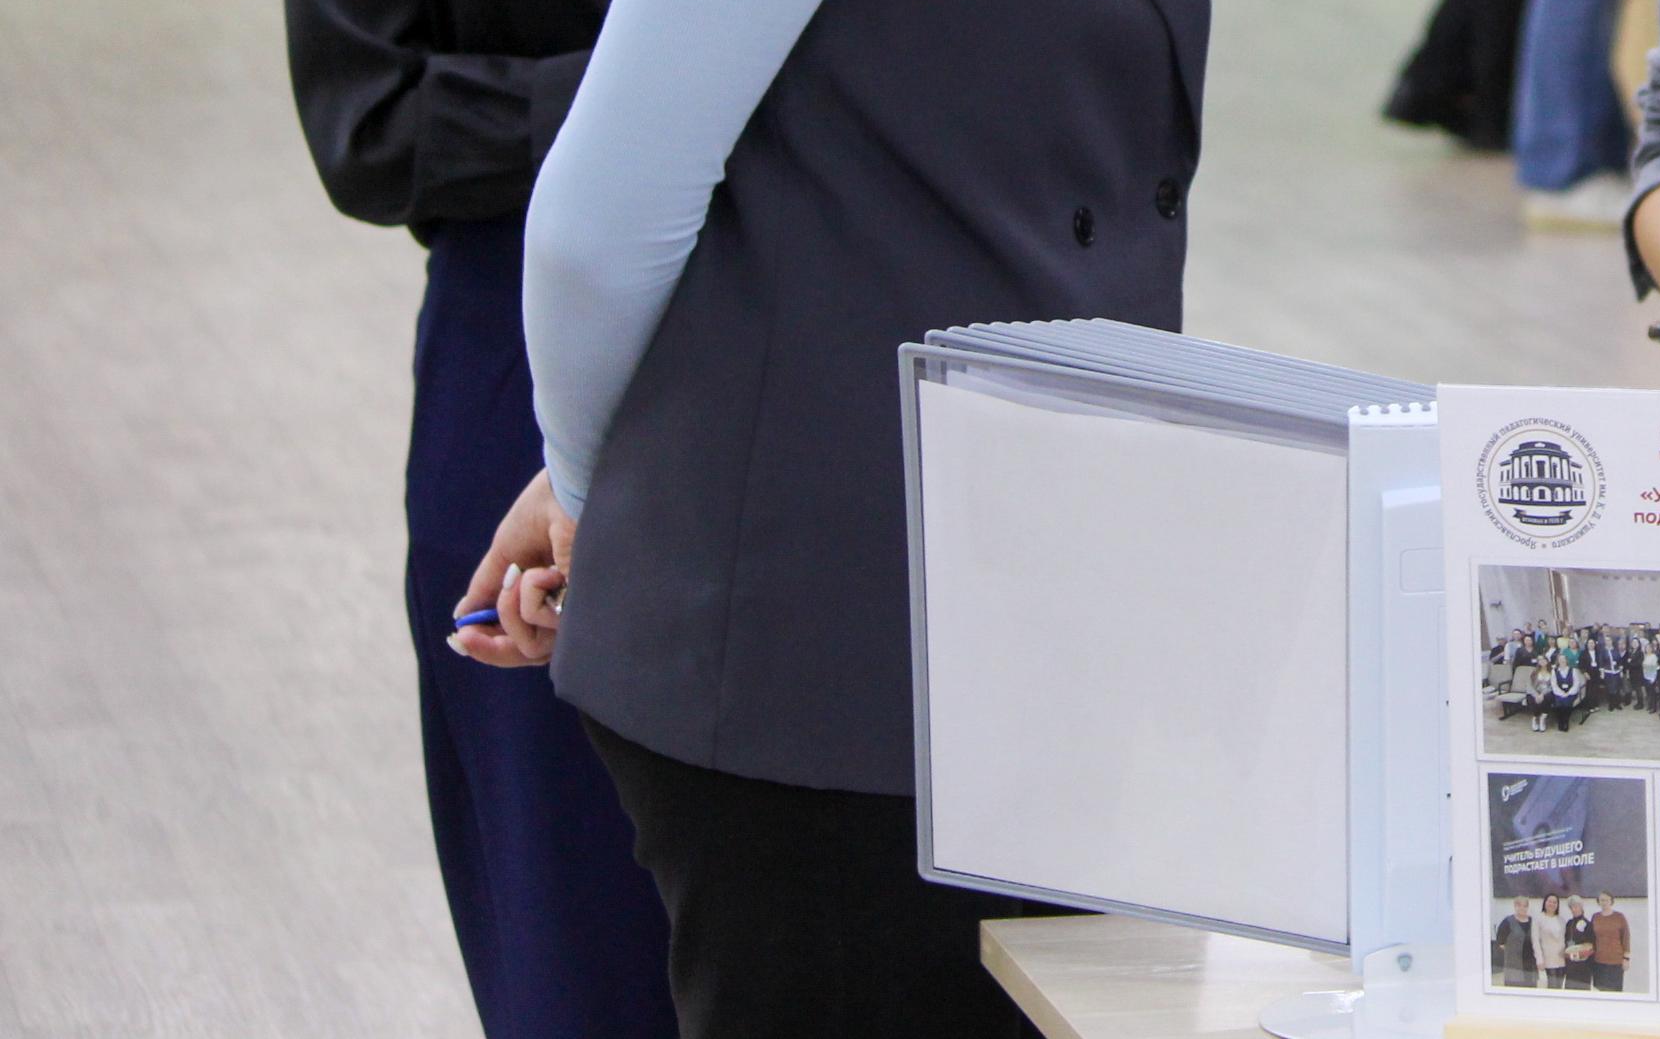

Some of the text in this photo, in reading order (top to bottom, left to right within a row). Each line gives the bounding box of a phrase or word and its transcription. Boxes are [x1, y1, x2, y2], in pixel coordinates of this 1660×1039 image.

[1499, 417, 1572, 437] педагогический
[1476, 432, 1500, 509] государственный
[1569, 428, 1606, 482] университет
[1485, 508, 1537, 550] Ярославский
[1503, 852, 1596, 875] ПОДРАСТАЕТ В ШКОЛЕ
[1534, 840, 1584, 860] БУДУЩЕГО
